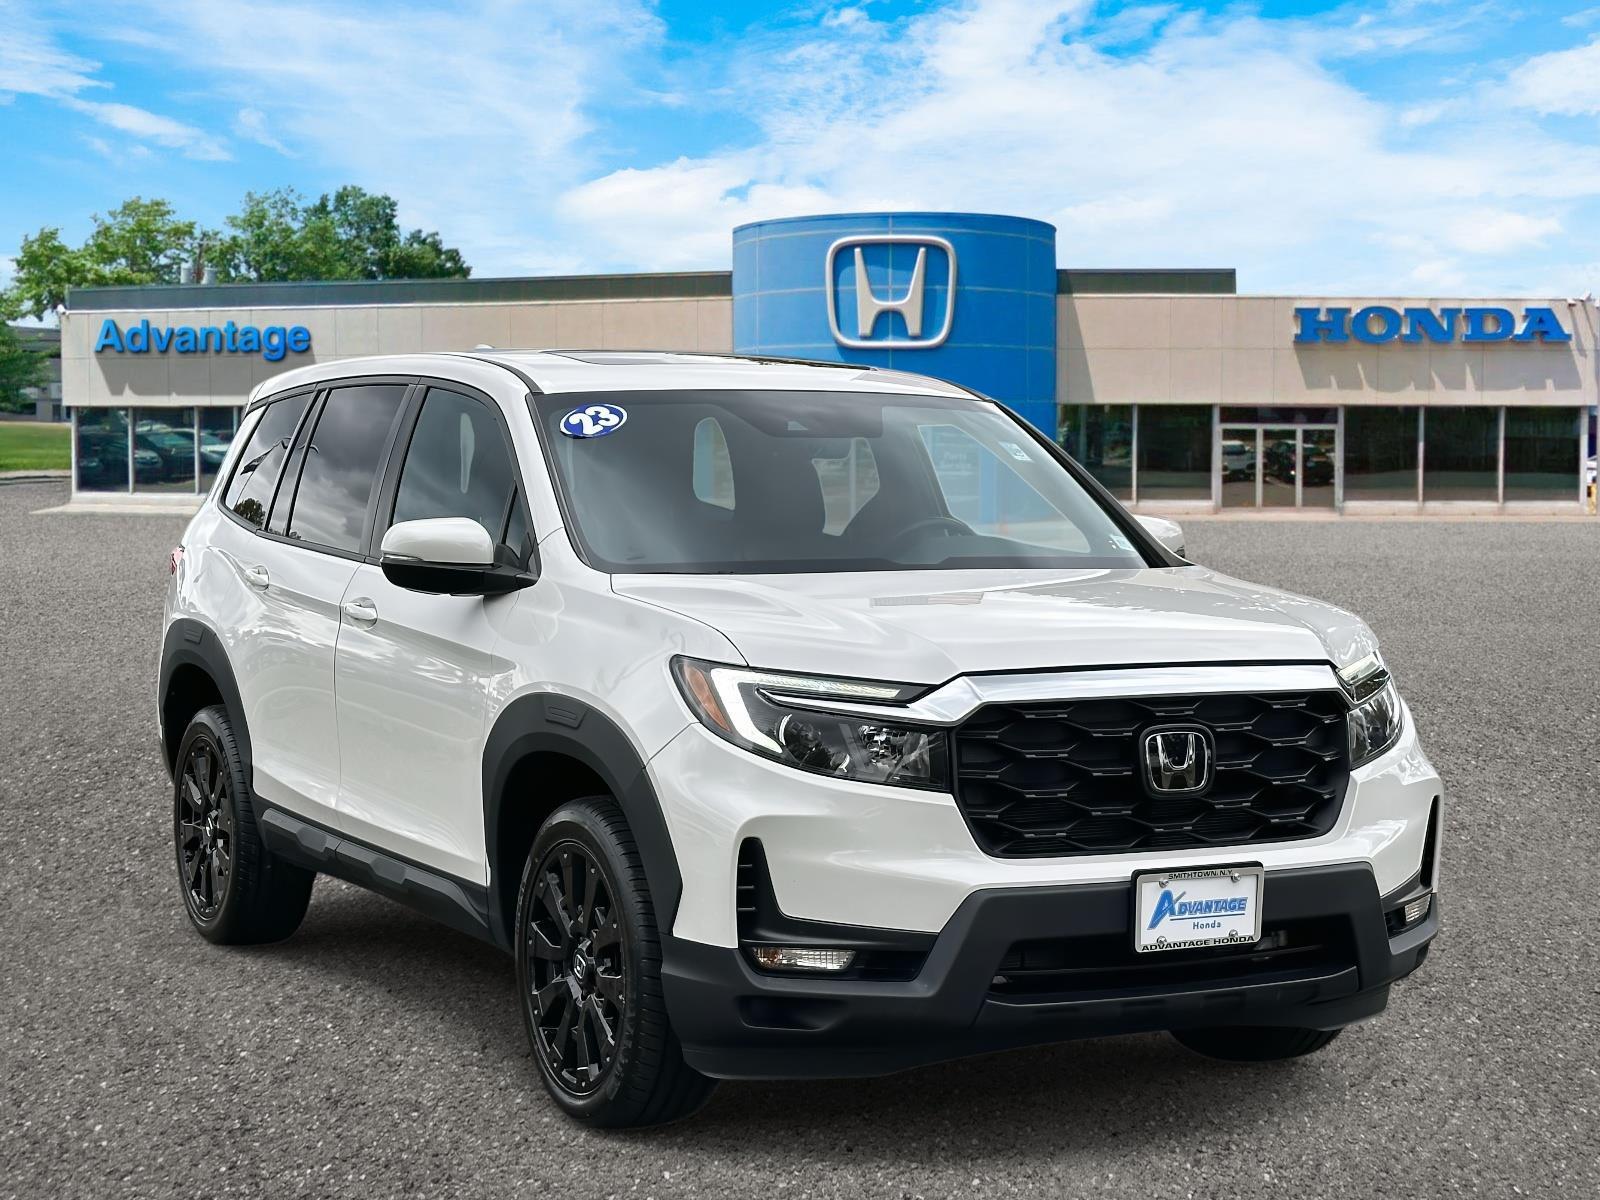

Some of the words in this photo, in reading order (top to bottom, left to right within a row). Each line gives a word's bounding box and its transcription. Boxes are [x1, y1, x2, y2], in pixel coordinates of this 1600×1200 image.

[1294, 306, 1572, 343] HONDA
[95, 319, 311, 362] Advantage
[569, 406, 620, 435] 23
[1192, 920, 1222, 930] Honda
[1141, 939, 1211, 952] ADVANTAGE
[1213, 935, 1256, 945] HONDA
